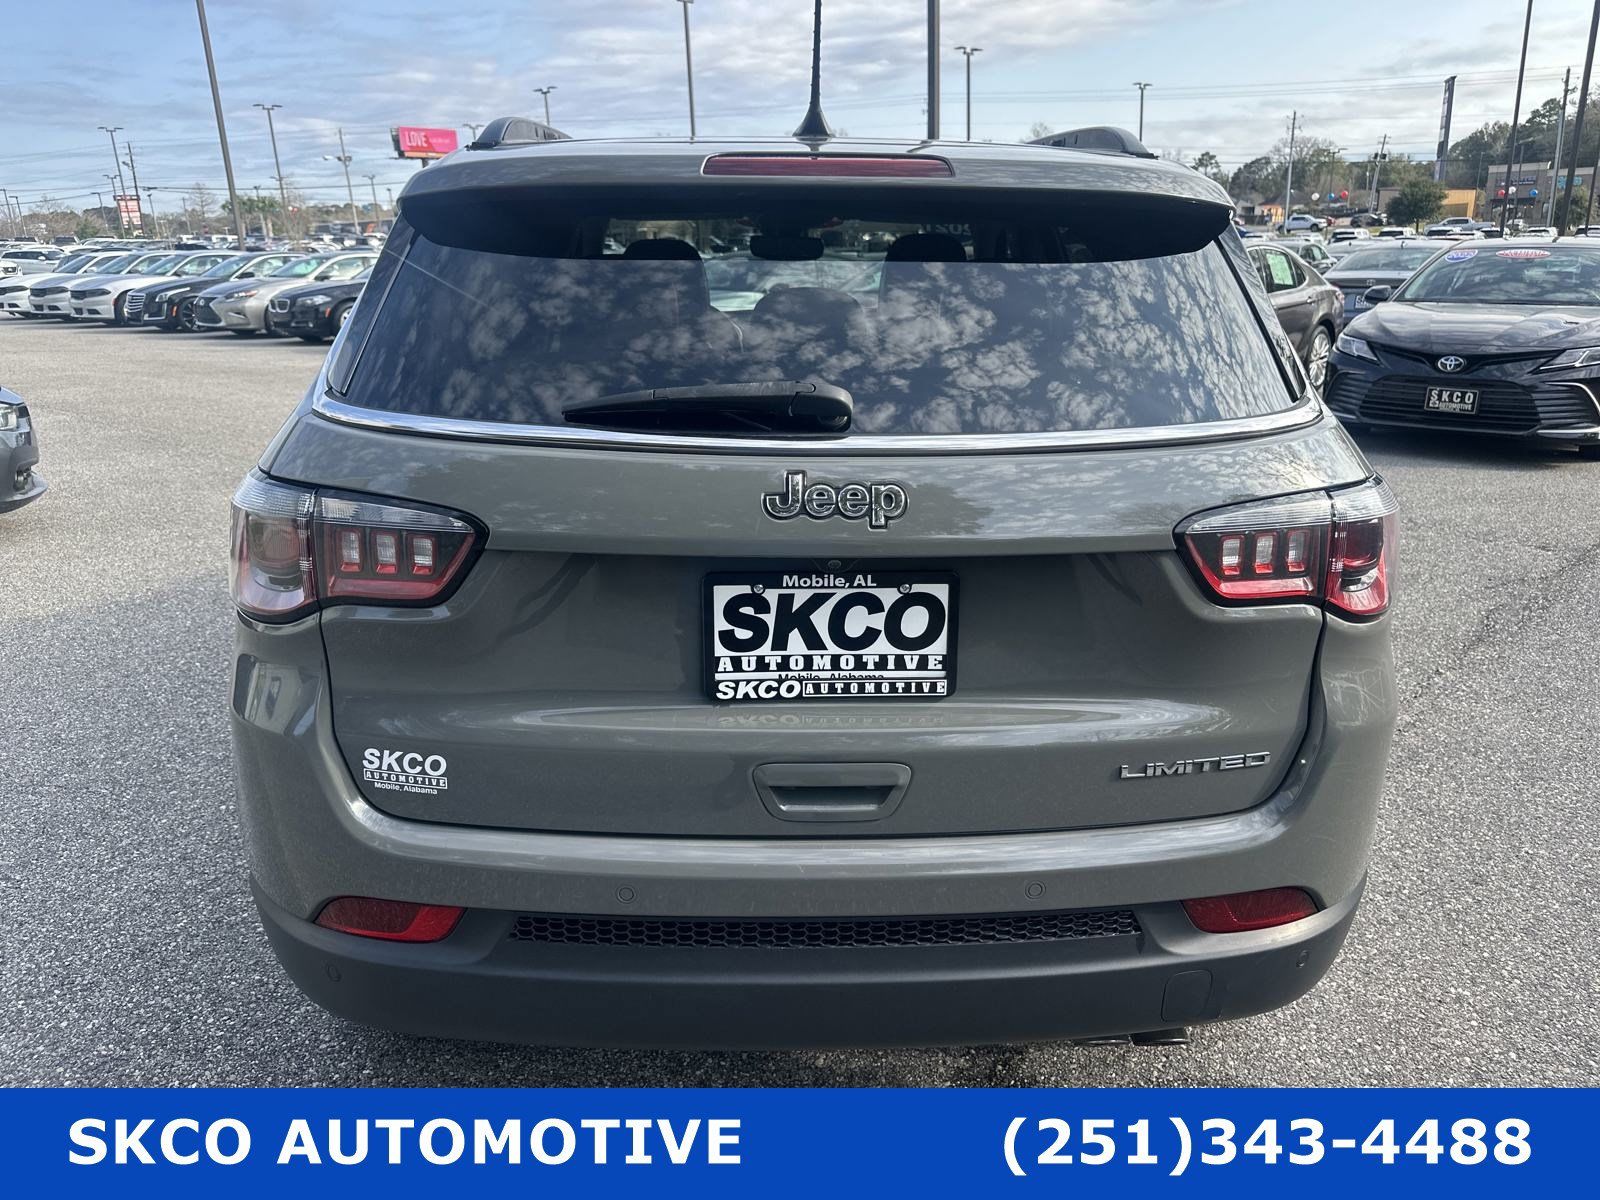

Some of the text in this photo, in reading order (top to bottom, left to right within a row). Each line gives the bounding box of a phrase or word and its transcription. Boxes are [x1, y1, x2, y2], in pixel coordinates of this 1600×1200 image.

[404, 131, 428, 147] LOVE
[1430, 390, 1474, 404] SKCO
[761, 470, 909, 531] Jeep
[782, 575, 877, 589] Mobile, AL
[718, 592, 946, 653] SKCO
[717, 655, 943, 672] AUTOMOTIVE
[716, 681, 946, 699] SKCO AUTOMOTIVE
[362, 748, 447, 776] SKCO
[1120, 751, 1271, 779] LIMITED
[366, 771, 446, 787] AUTOMOTIVE
[374, 782, 438, 795] Mobile, Alabama
